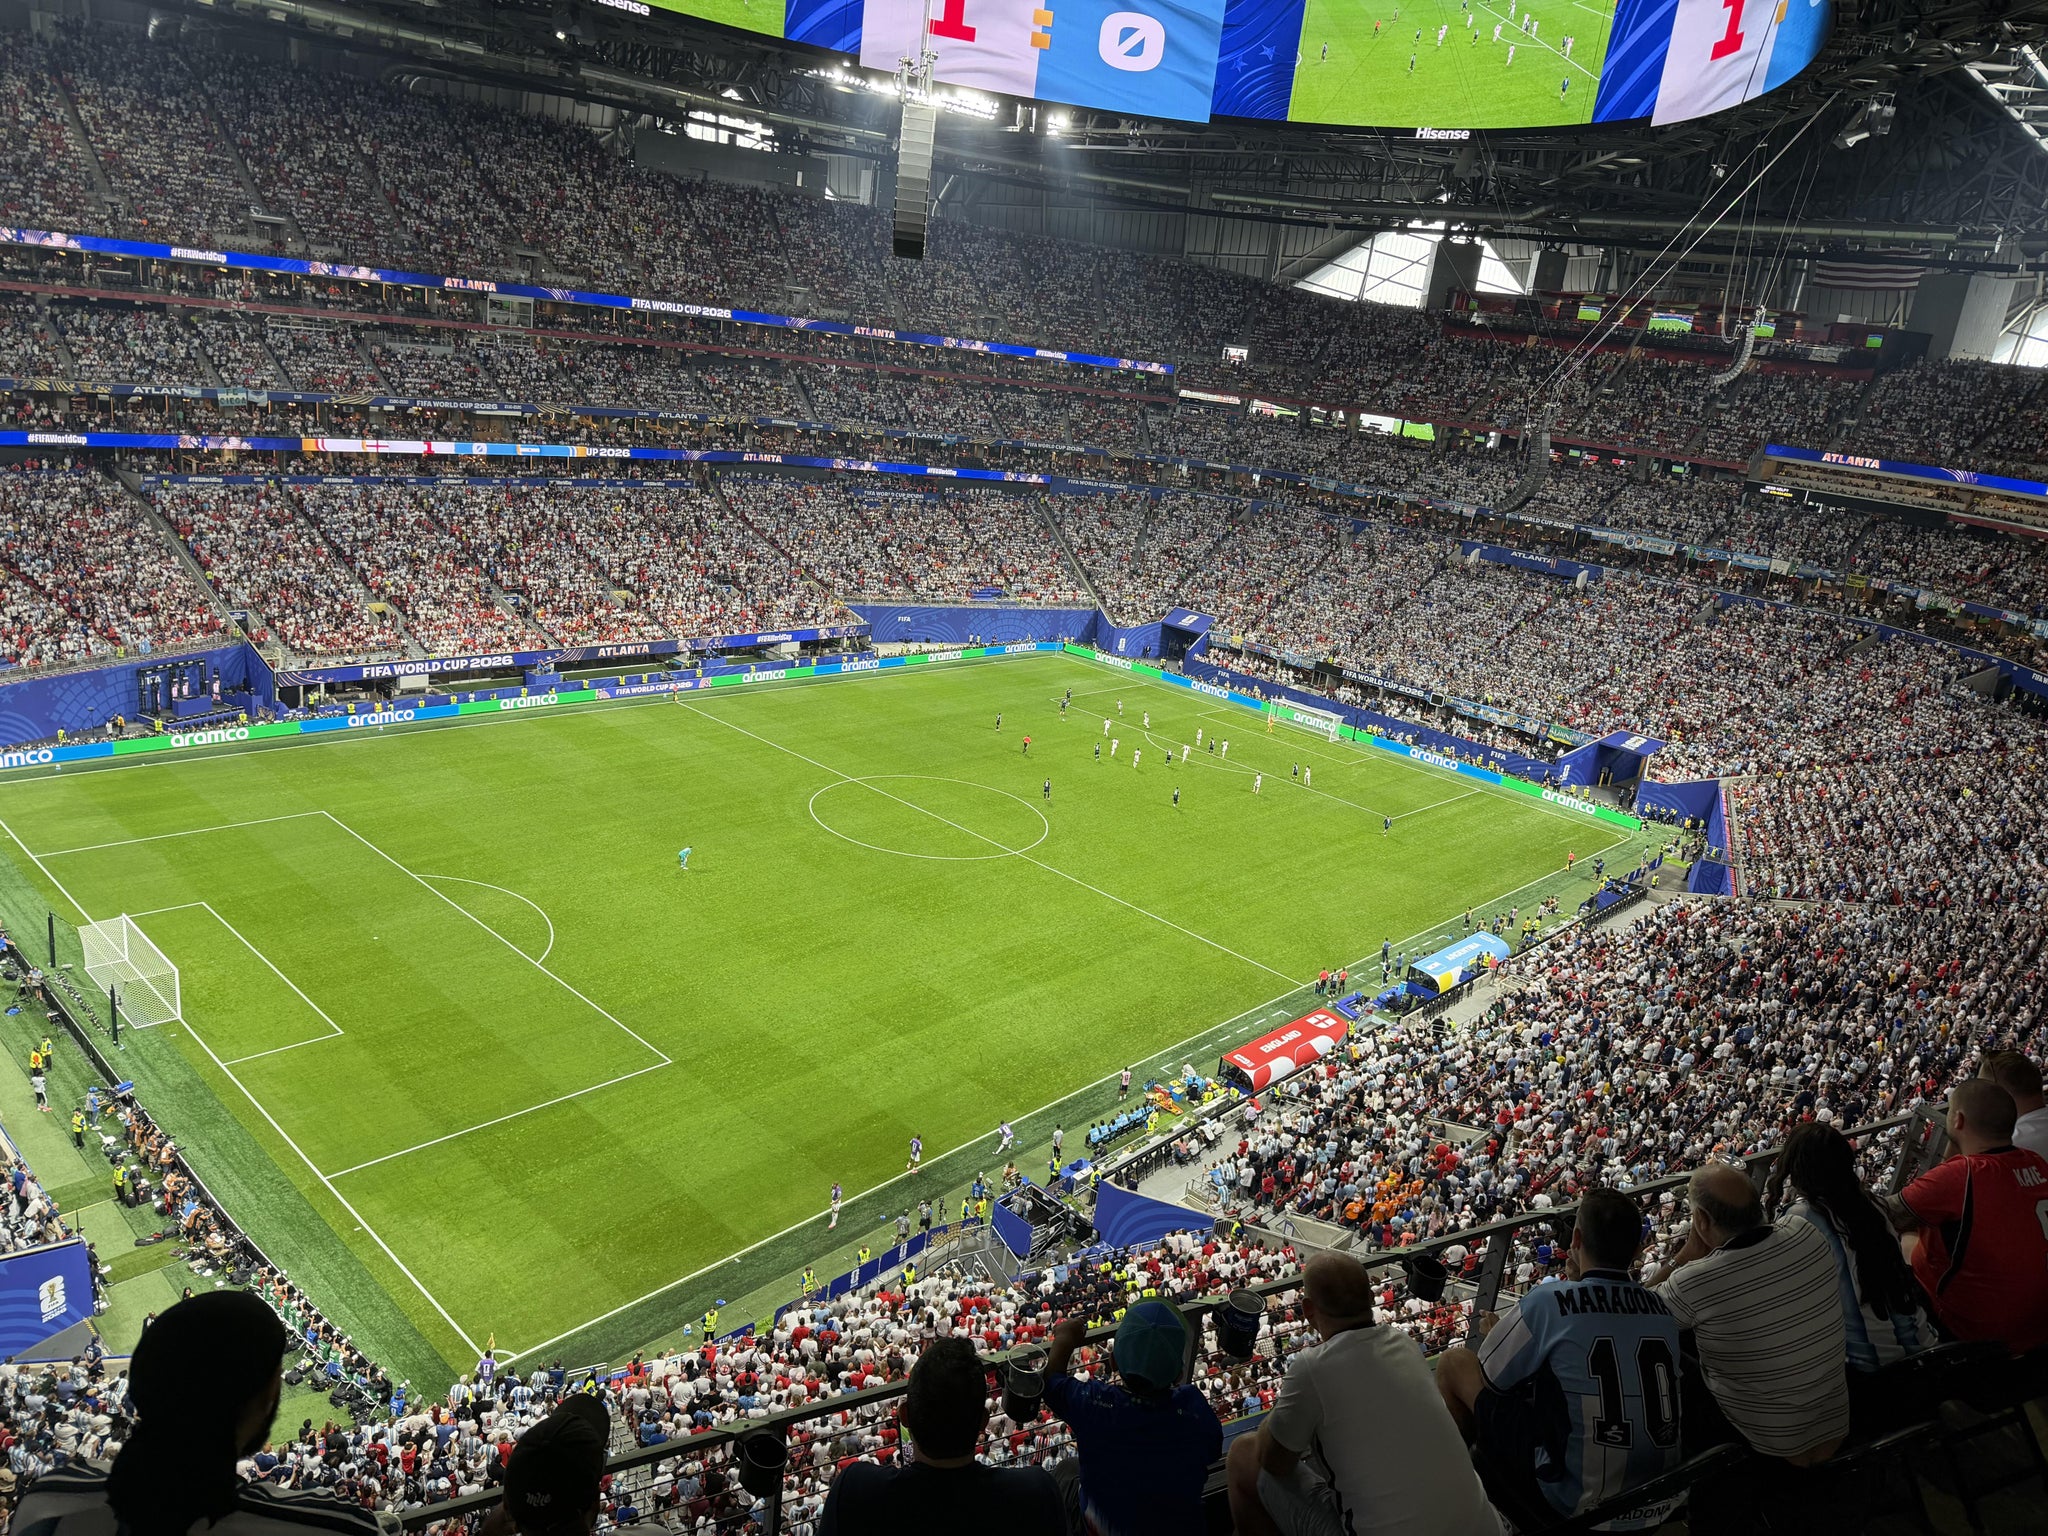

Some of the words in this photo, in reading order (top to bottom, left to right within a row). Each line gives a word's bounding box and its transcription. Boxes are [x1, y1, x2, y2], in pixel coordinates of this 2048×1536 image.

[1710, 0, 1746, 62] 1
[1099, 12, 1165, 71] 0
[1415, 128, 1470, 139] Hisense
[170, 247, 227, 263] #FIFAWorldCup
[444, 278, 497, 292] ATLANTA
[632, 299, 651, 310] FIFA
[652, 301, 684, 313] WORLD
[685, 305, 702, 314] CUP
[702, 307, 732, 318] 2026
[854, 326, 896, 339] ATLANTA
[433, 401, 458, 409] WORLD
[28, 434, 88, 446] #FIFAWorldCup
[906, 432, 943, 441] ATLANTA
[423, 442, 434, 454] 1
[600, 448, 630, 457] 2026
[743, 453, 783, 463] ATLANTA
[1821, 452, 1881, 469] ATLANTA
[1080, 480, 1099, 488] WORLD
[1519, 515, 1540, 523] WORLD
[1553, 521, 1575, 530] 2026
[598, 644, 649, 657] ATLANTA
[928, 649, 963, 662] aramco
[1004, 643, 1037, 654] aramco
[363, 666, 393, 678] FIFA
[394, 661, 442, 675] WORLD
[443, 658, 470, 671] CUP
[470, 655, 514, 669] 2026
[841, 659, 880, 672] aramco
[1095, 651, 1134, 670] aramco
[742, 669, 786, 683] aramco
[1217, 670, 1230, 680] FIFA
[616, 687, 631, 696] FIFA
[632, 684, 655, 694] WORLD
[656, 683, 669, 692] CUP
[1190, 679, 1229, 700] aramco
[1342, 670, 1357, 680] FIFA
[1357, 673, 1383, 686] WORLD
[1383, 678, 1399, 690] CUP
[1398, 684, 1425, 697] 2026
[500, 694, 558, 711] aramco
[348, 709, 415, 728] aramco
[1293, 710, 1337, 732] aramco
[170, 727, 249, 749] aramco
[1409, 747, 1458, 771] aramco
[1490, 750, 1507, 762] FIFA
[1541, 789, 1597, 814] aramco
[1259, 1030, 1302, 1053] ENGLAND
[1586, 1336, 1677, 1449] 10
